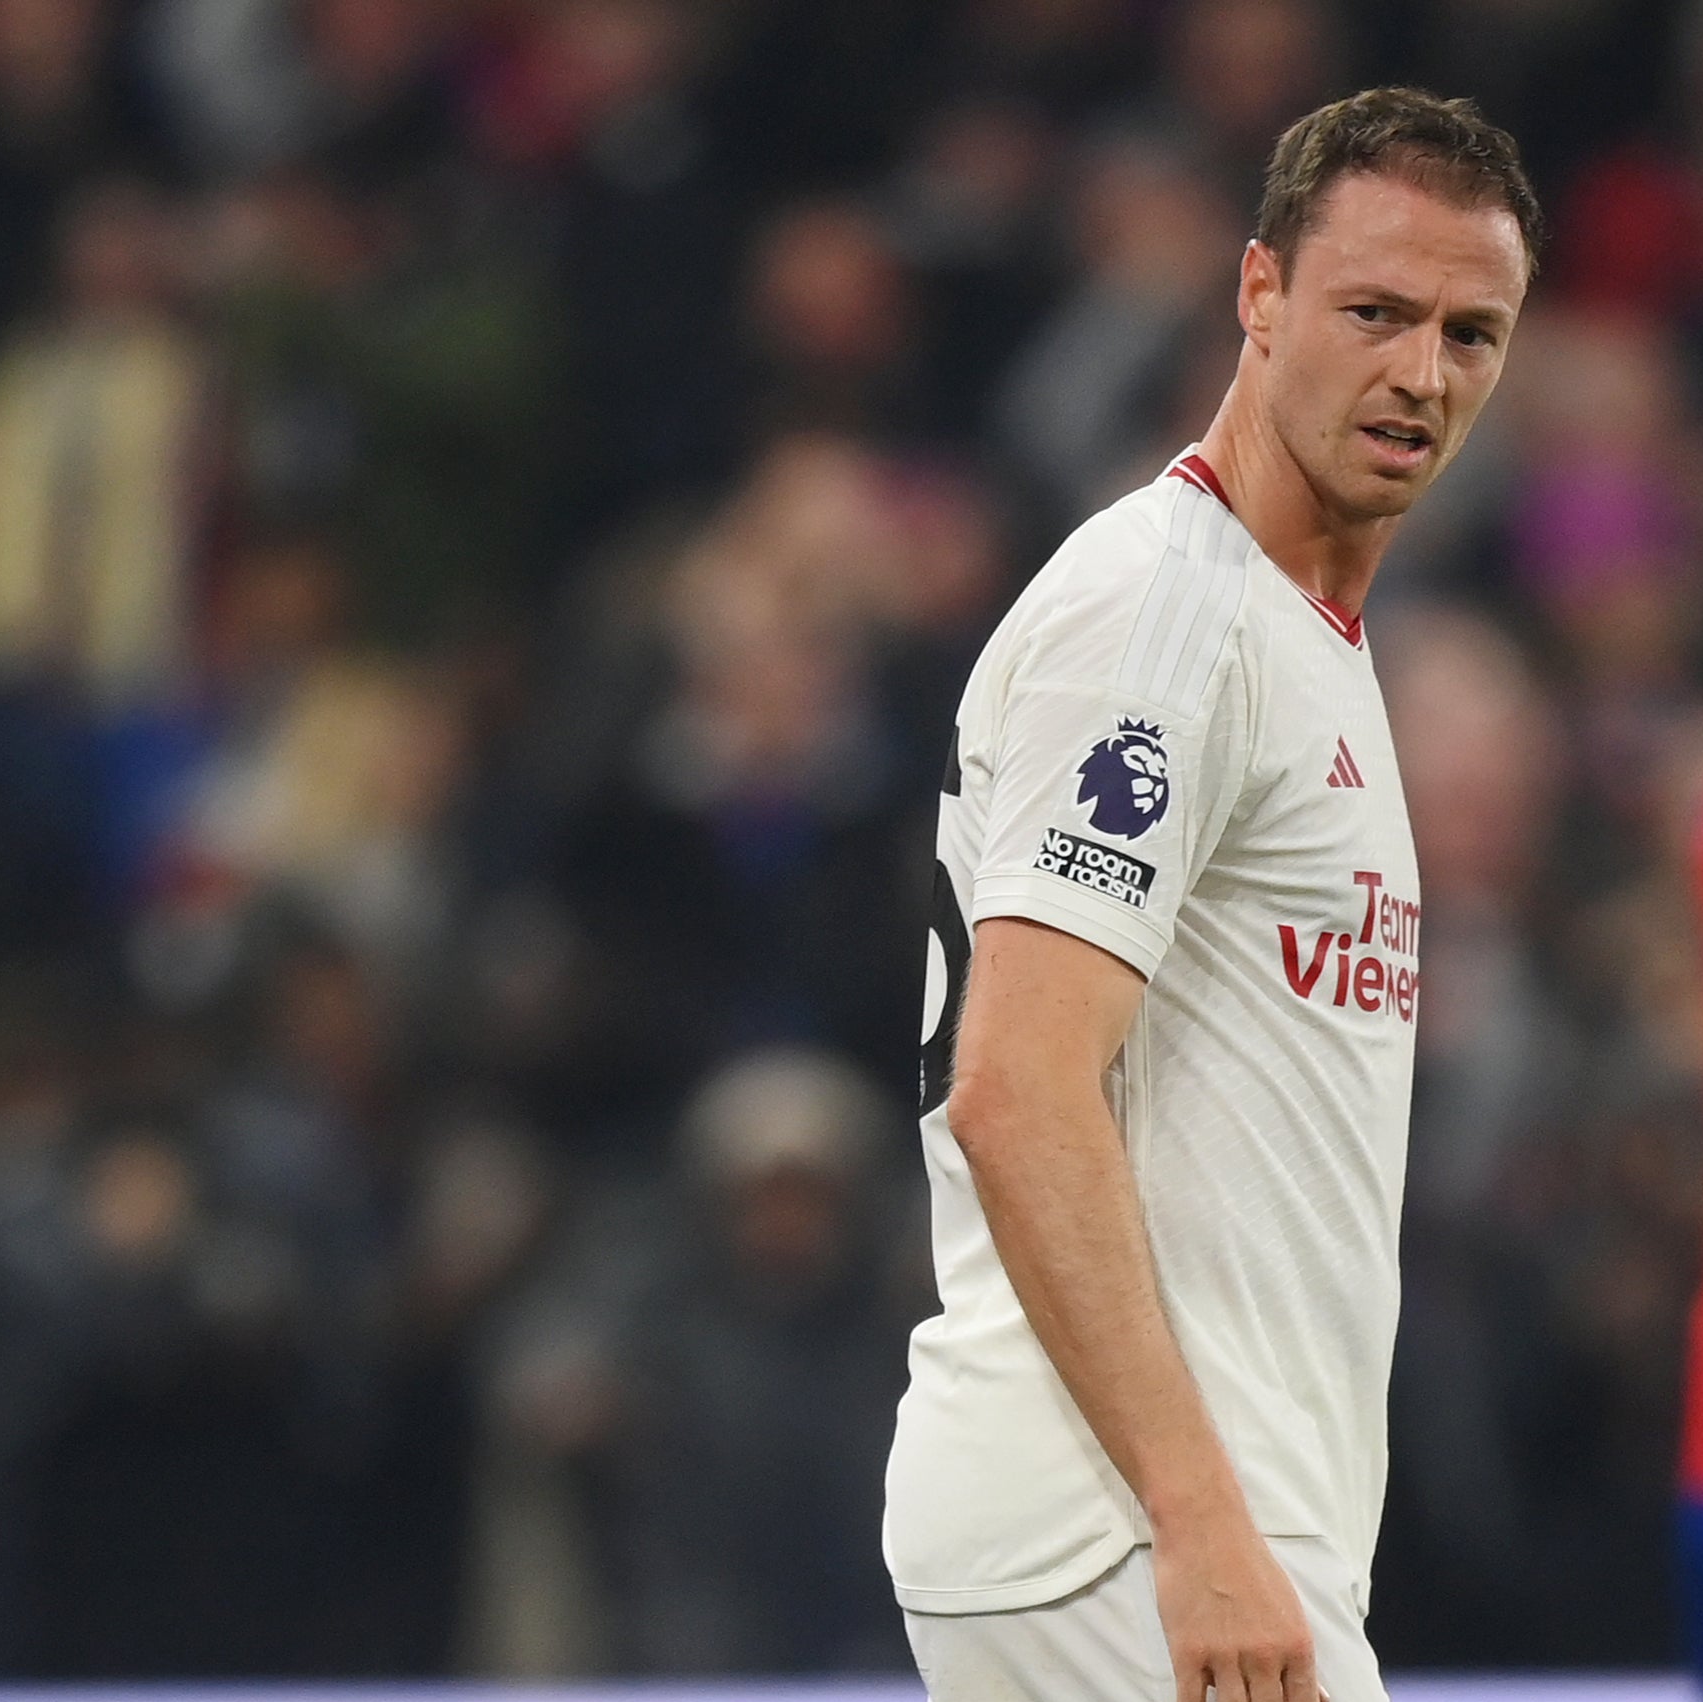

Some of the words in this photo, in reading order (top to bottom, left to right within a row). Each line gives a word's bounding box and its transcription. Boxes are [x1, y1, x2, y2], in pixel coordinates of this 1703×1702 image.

[1039, 829, 1074, 858] No
[1074, 844, 1143, 886] room
[1066, 862, 1147, 910] racism
